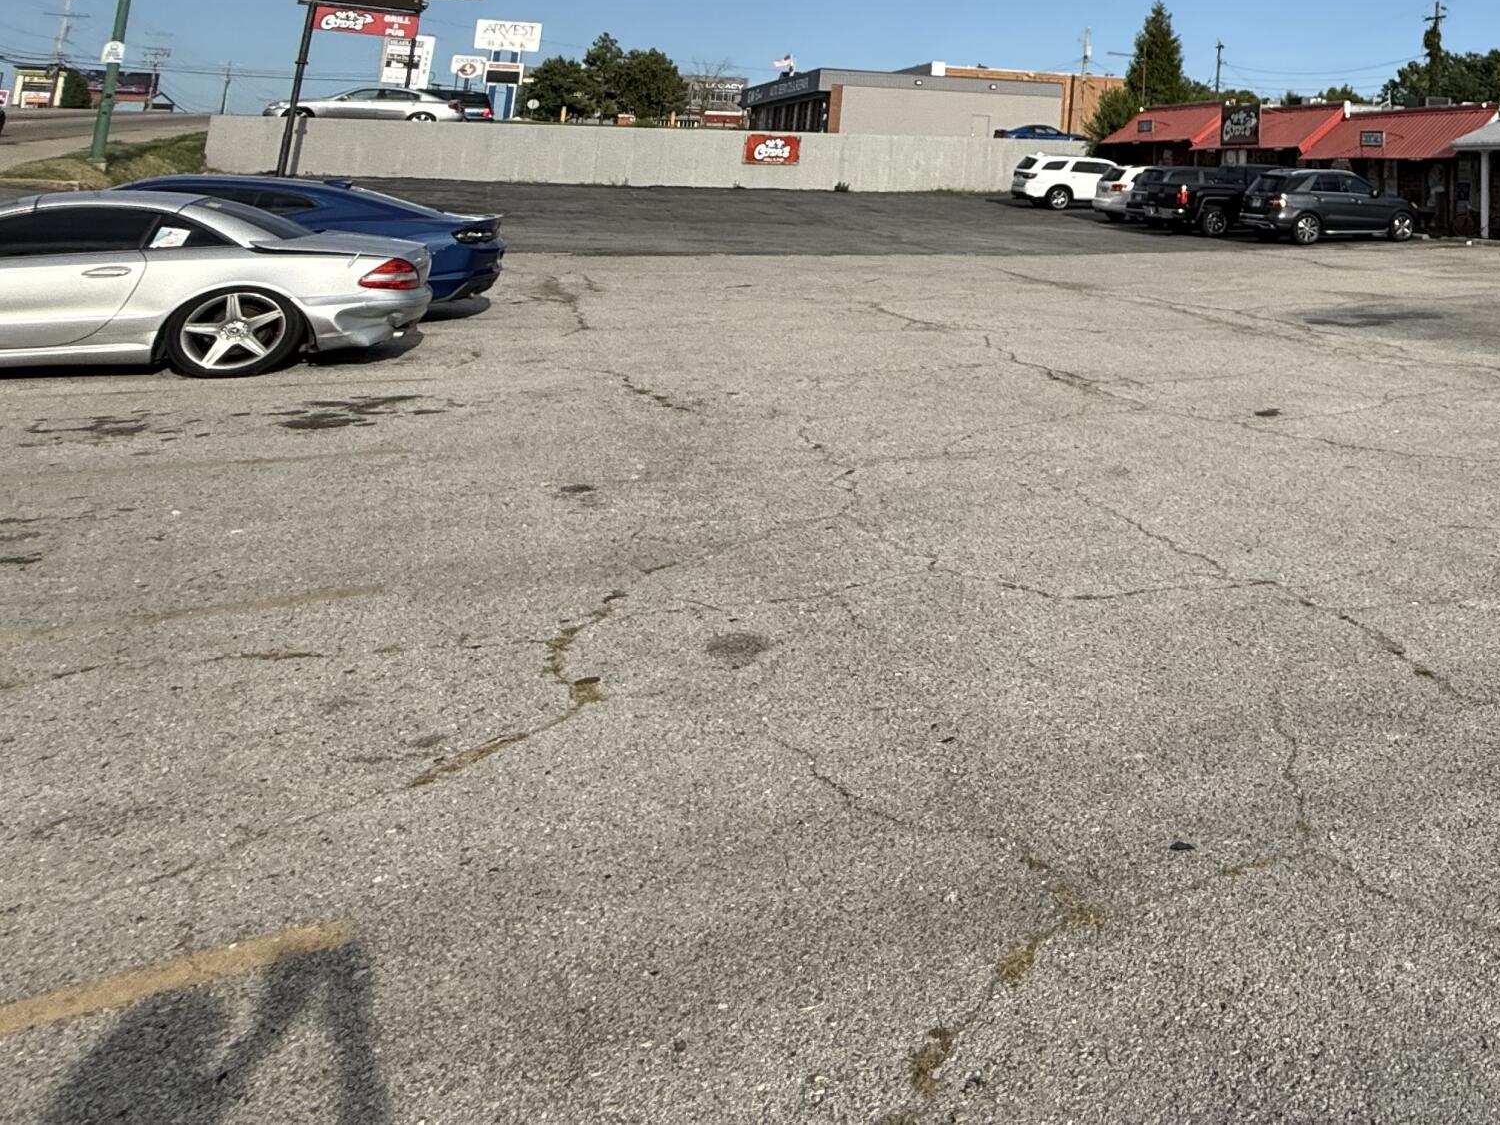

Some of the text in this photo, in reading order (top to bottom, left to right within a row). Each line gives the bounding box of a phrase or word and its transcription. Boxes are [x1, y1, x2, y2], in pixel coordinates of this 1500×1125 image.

[384, 15, 411, 25] GRILL
[385, 28, 405, 36] PUB
[483, 23, 536, 39] ARVEST
